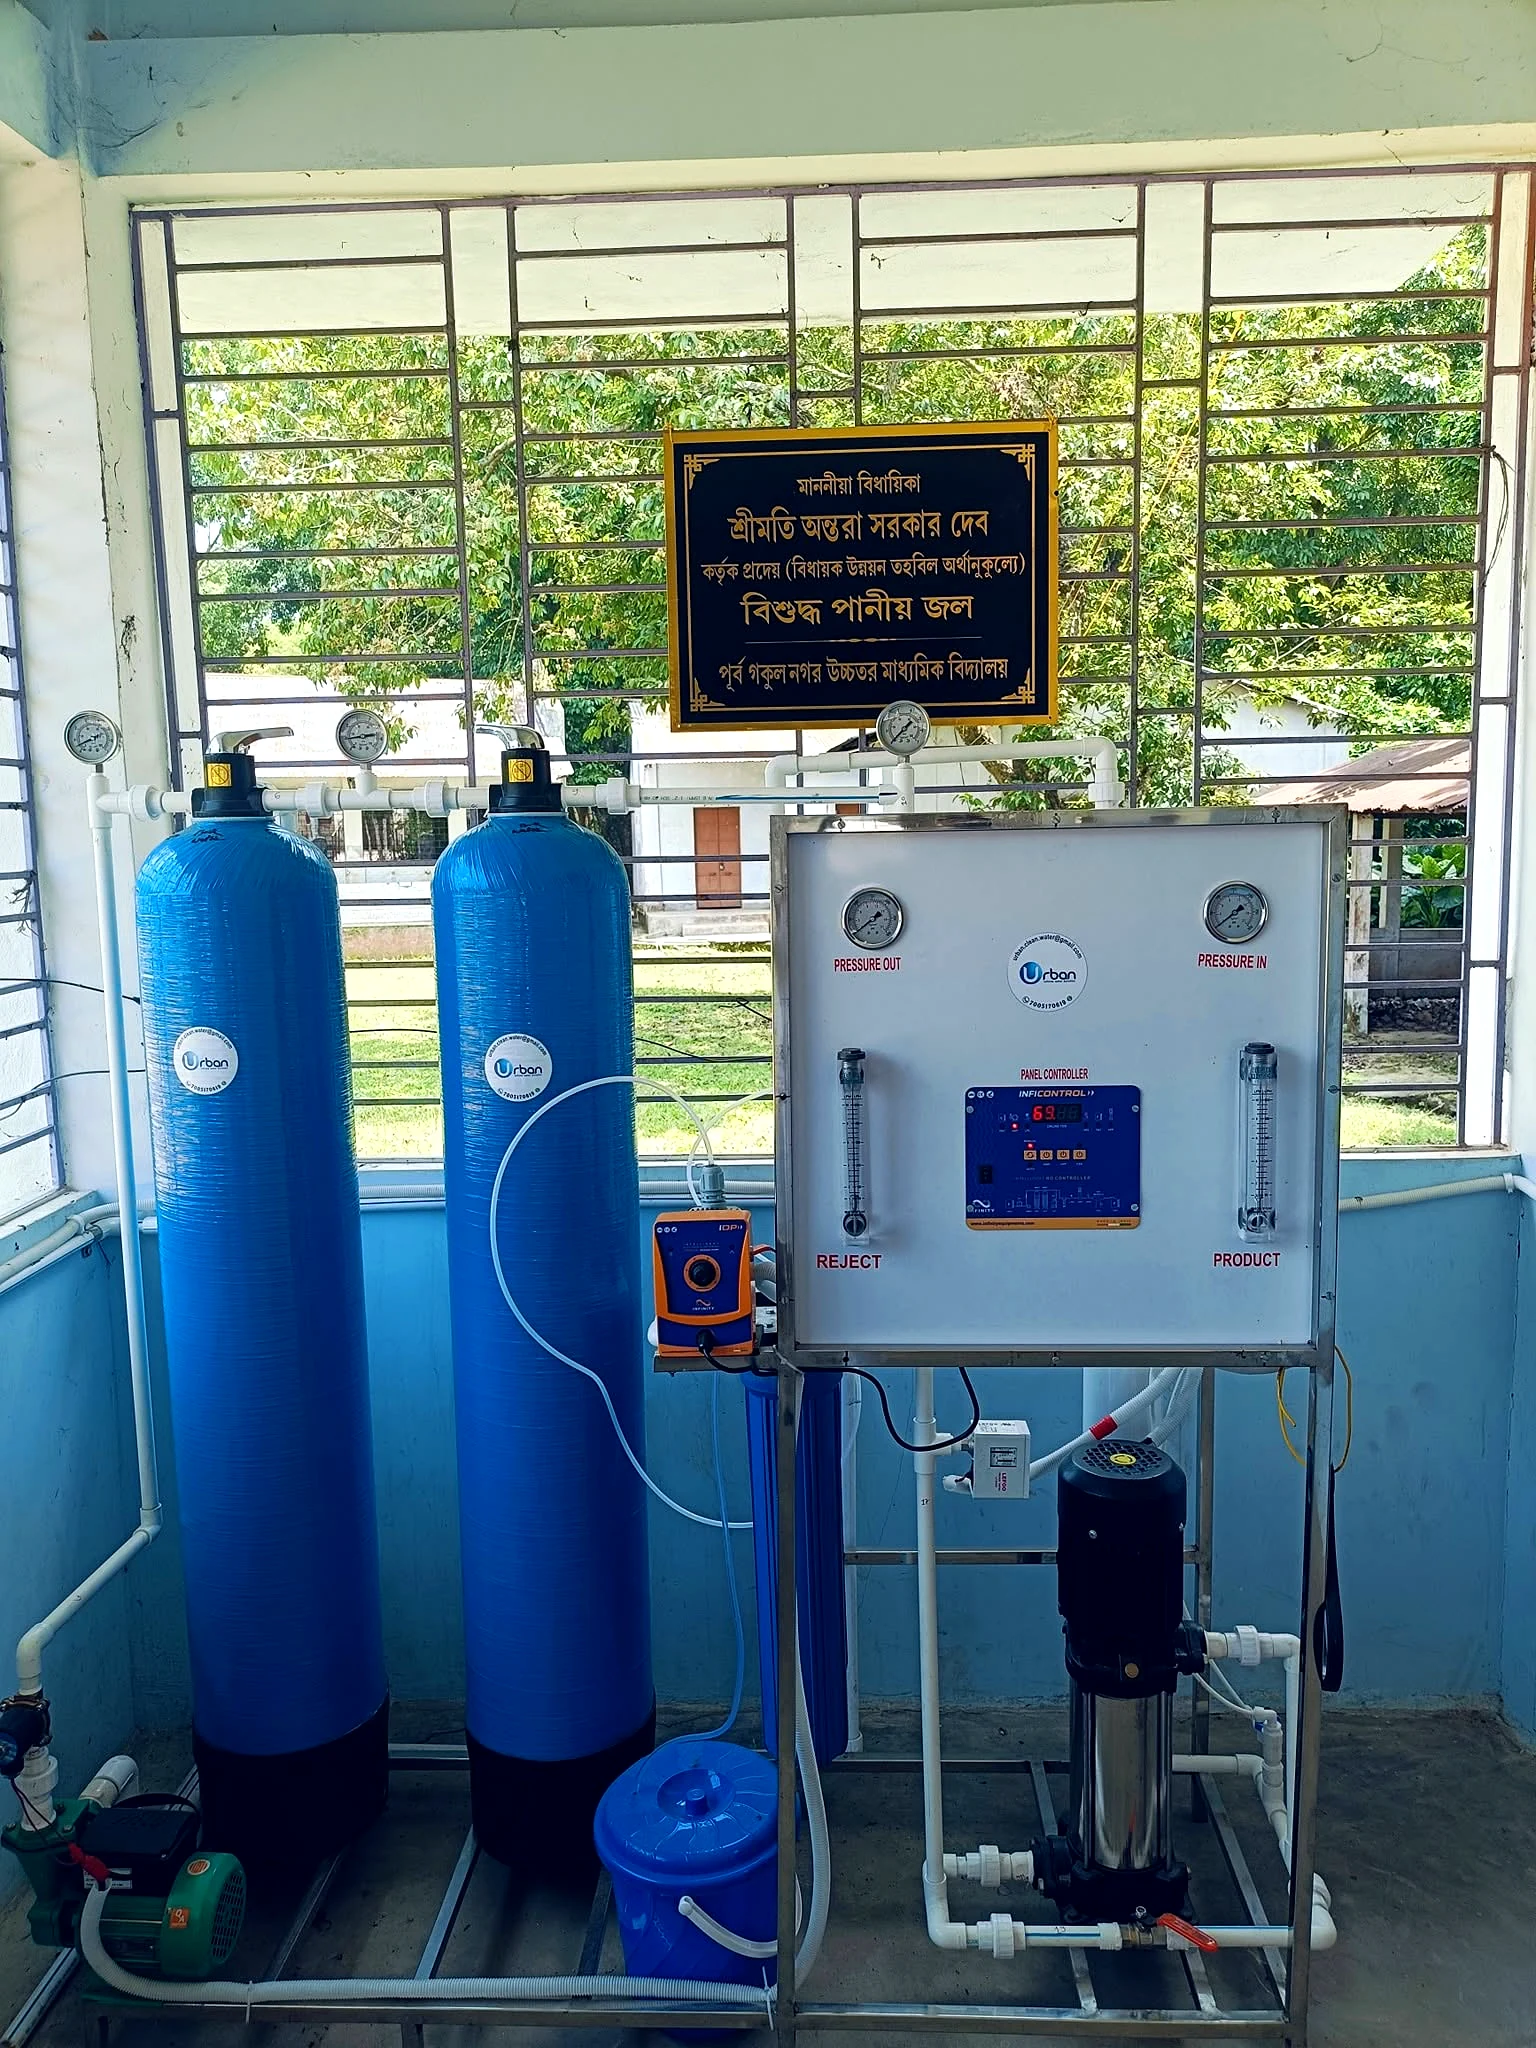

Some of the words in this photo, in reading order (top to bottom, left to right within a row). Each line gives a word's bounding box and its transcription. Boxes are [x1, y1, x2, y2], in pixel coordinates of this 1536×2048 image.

[797, 471, 853, 496] মাননীয়া
[857, 469, 921, 494] বিধায়িকা
[727, 506, 797, 544] শ্রীমতি
[800, 511, 863, 542] অন্তরা
[868, 509, 942, 540] সরকার
[951, 511, 989, 537] দেব
[701, 556, 739, 586] কর্তৃক
[845, 555, 886, 577] উন্নয়ন
[890, 552, 938, 577] তহবিল
[739, 592, 823, 625] বিশুদ্ধ
[831, 588, 914, 623] পানীয়
[920, 595, 974, 620] জল
[719, 656, 746, 692] পূর্ব
[826, 656, 878, 682] উচ্চতর
[880, 652, 944, 683] মাধ্যমিক
[947, 652, 1008, 681] বিদ্যালয়
[834, 957, 881, 972] PRESSURE
[883, 957, 901, 970] OUT
[1198, 953, 1254, 968] PRESSURE
[1256, 955, 1267, 968] IN
[1021, 963, 1076, 984] Urban
[183, 1053, 229, 1070] Urban
[495, 1060, 542, 1077] Urban
[1020, 1069, 1042, 1080] PANEL
[1044, 1068, 1088, 1080] CONTROLLER
[1019, 1089, 1086, 1098] INFICONTROL
[816, 1254, 881, 1269] REJECT
[1213, 1252, 1281, 1267] PRODUCT
